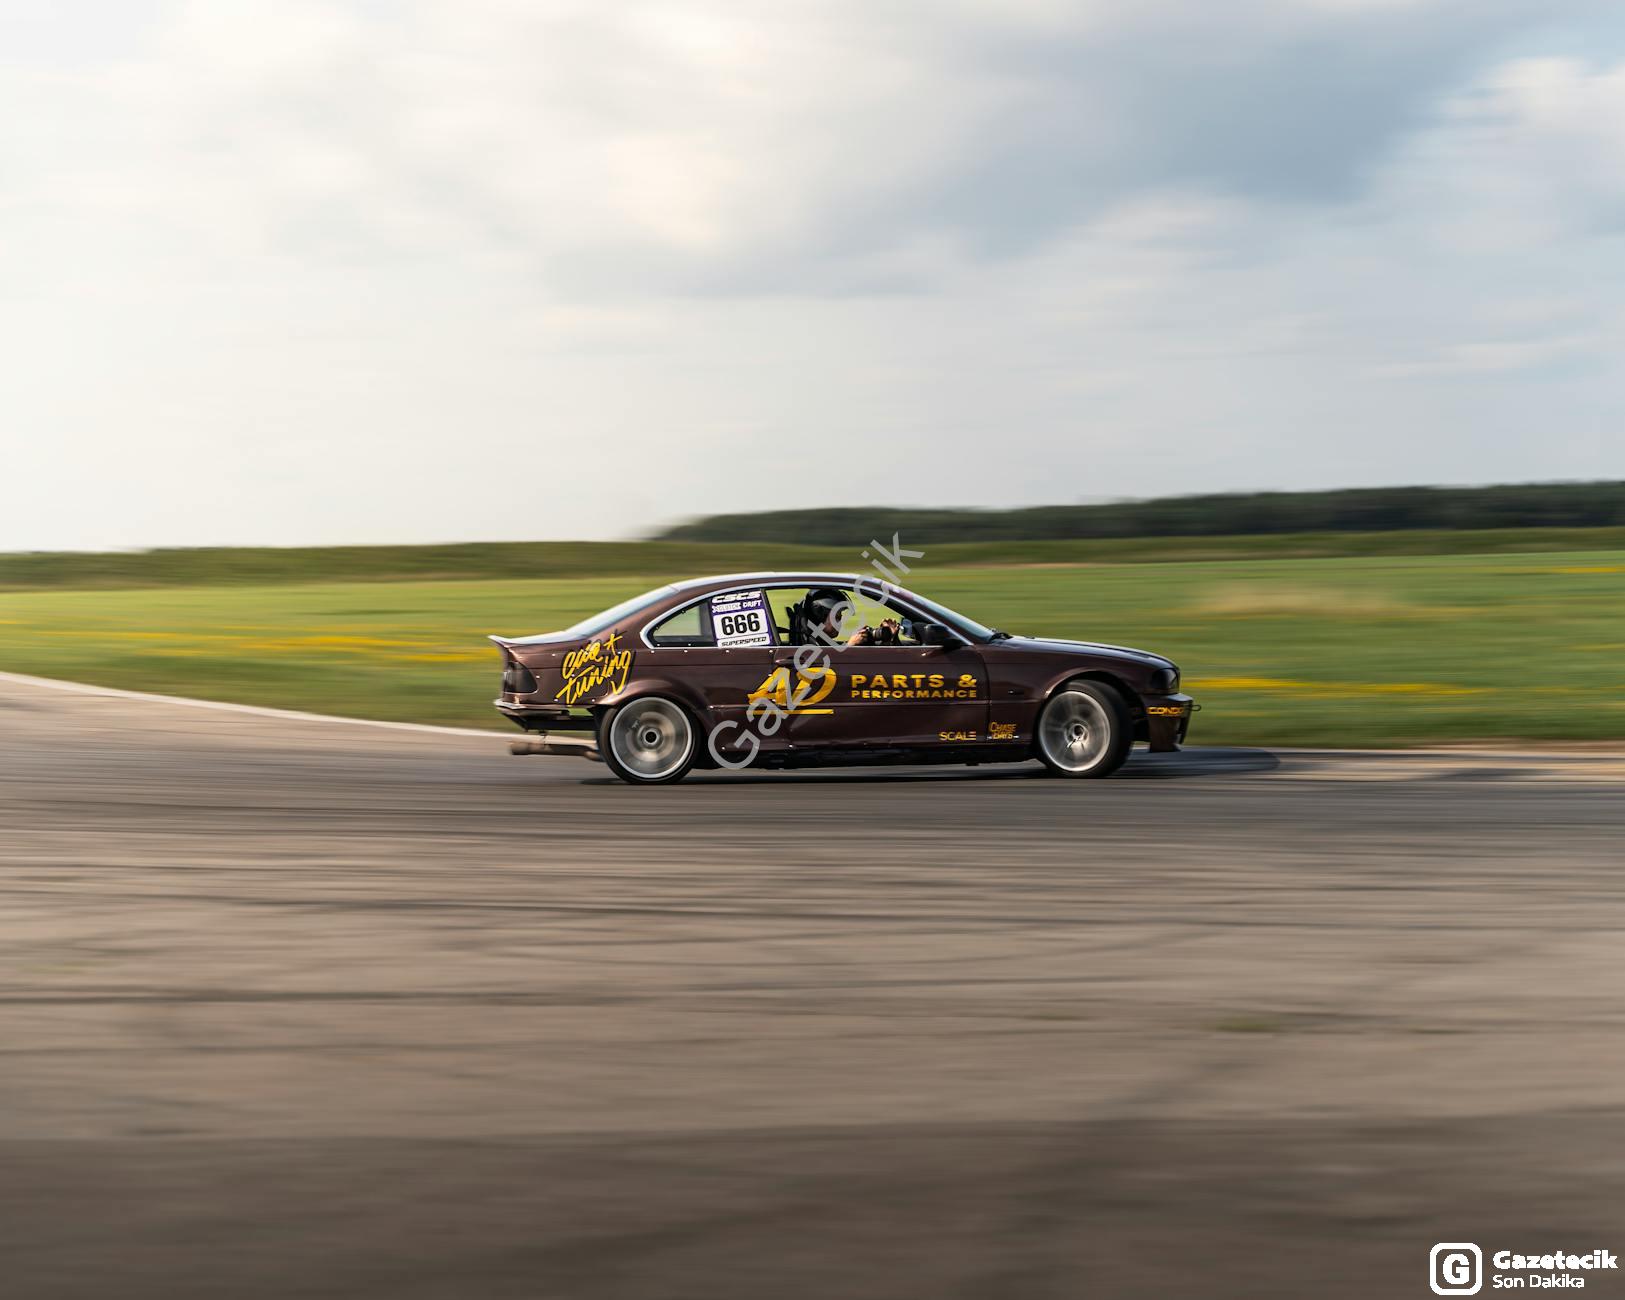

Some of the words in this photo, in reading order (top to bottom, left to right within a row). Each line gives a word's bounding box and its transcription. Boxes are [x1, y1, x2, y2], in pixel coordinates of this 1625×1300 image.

[712, 591, 762, 604] CSCS
[742, 600, 762, 608] DRIFT
[721, 613, 760, 636] 666
[721, 636, 767, 647] SUPERSPEED
[851, 674, 945, 688] PARTS
[958, 674, 977, 688] &
[851, 690, 977, 699] PERFORMANCE
[939, 731, 977, 741] SCALE
